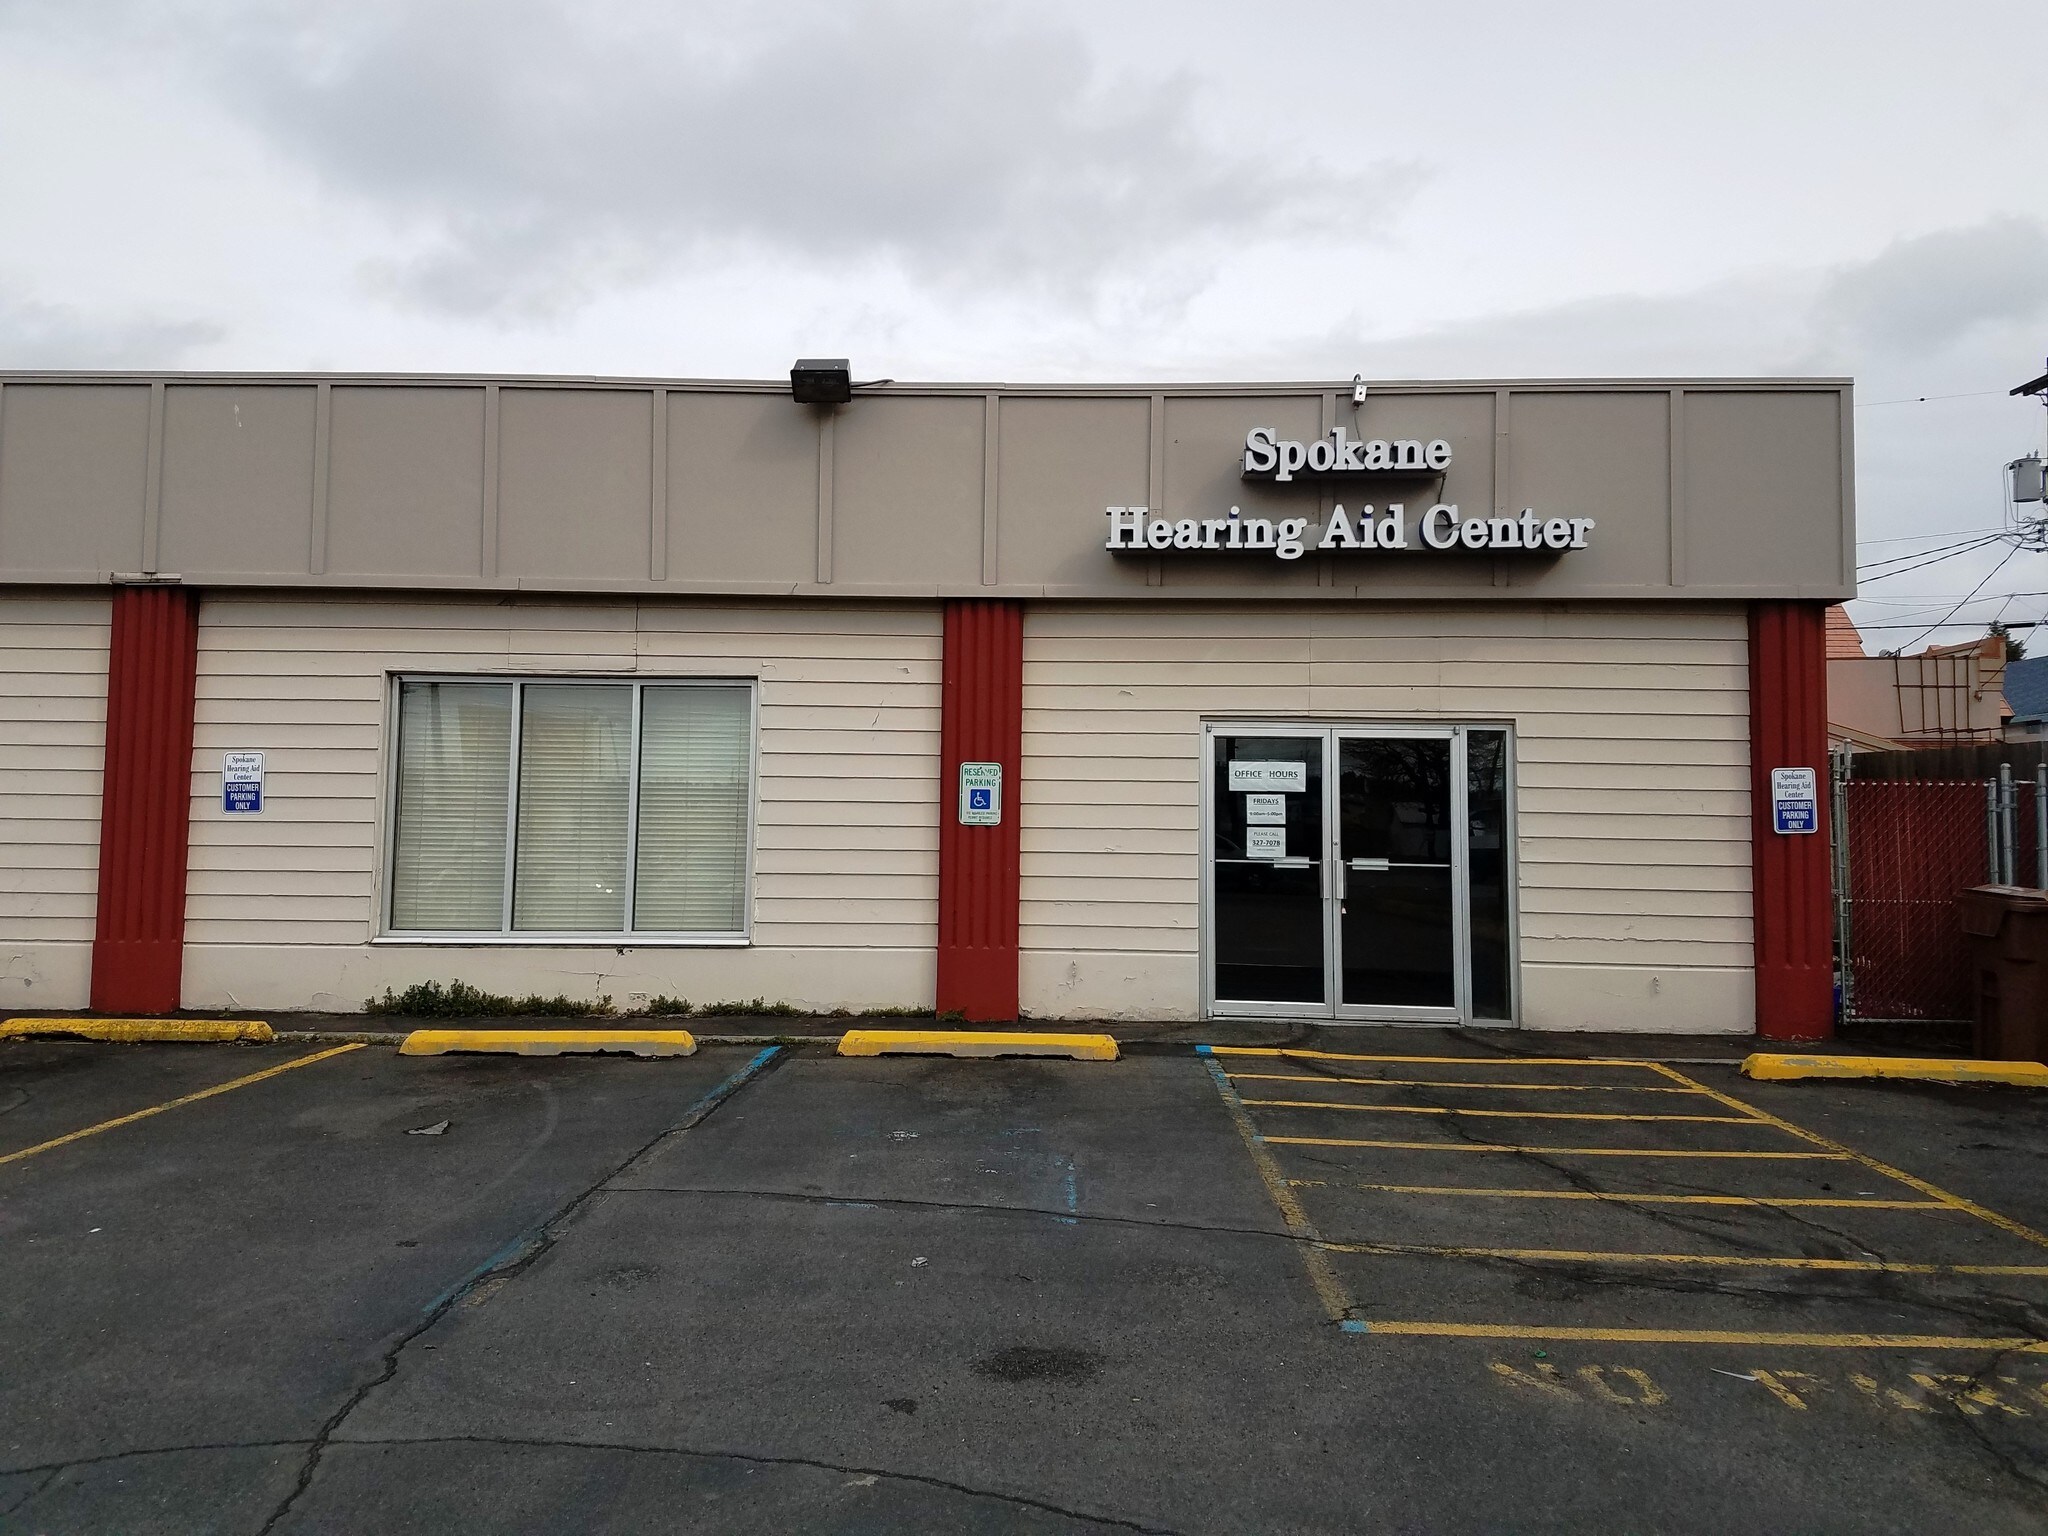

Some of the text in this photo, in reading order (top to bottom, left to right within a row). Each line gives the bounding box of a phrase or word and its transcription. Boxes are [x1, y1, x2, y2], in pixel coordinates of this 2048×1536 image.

[1244, 427, 1453, 481] Spokane
[1105, 504, 1596, 560] Hearing Aid Center
[231, 755, 257, 764] Spokane
[226, 764, 260, 773] Hearing Aid
[1234, 770, 1298, 779] OFFICE HOURS
[1780, 771, 1807, 781] Spokane
[226, 783, 259, 791] CUSTOMER
[965, 778, 997, 787] PARKING
[1777, 781, 1811, 790] Hearing Aid
[230, 792, 256, 801] PARKING
[1784, 790, 1804, 798] Center
[235, 801, 250, 810] ONLY
[1778, 801, 1812, 810] CUSTOMER
[1782, 811, 1809, 820] PARKING
[1788, 820, 1804, 829] ONLY
